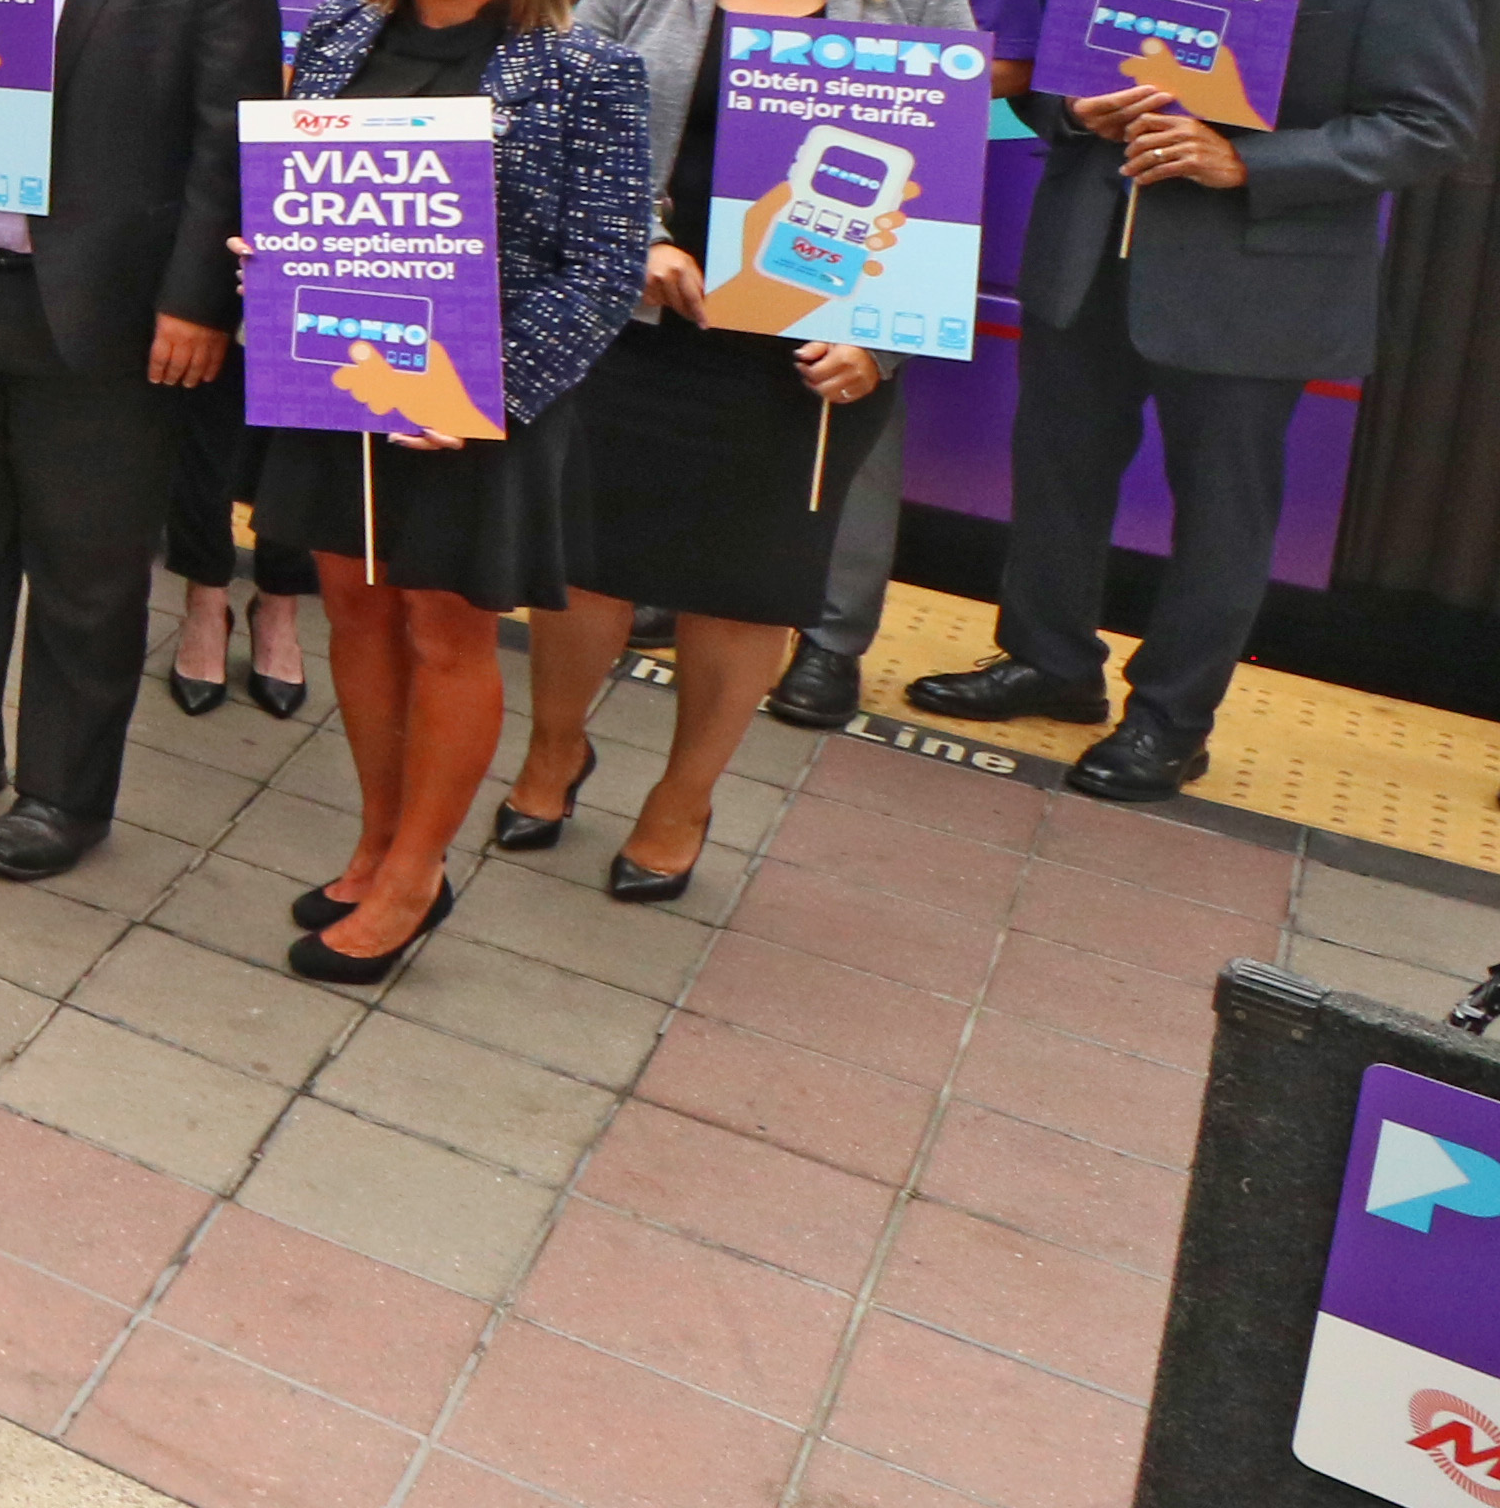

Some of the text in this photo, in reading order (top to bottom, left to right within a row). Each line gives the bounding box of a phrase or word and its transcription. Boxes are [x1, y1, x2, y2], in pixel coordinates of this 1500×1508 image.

[1094, 7, 1220, 48] PRONTO
[730, 27, 985, 80] PRONTO
[729, 69, 945, 105] Obtén siempre
[727, 91, 935, 128] la mejor tarifa.
[283, 150, 451, 190] ¡VIAJA
[273, 192, 462, 227] GRATIS
[254, 232, 484, 256] todo septiembre
[283, 260, 454, 279] con PRONTO!
[297, 313, 427, 346] PRONTO
[845, 712, 1017, 775] Line
